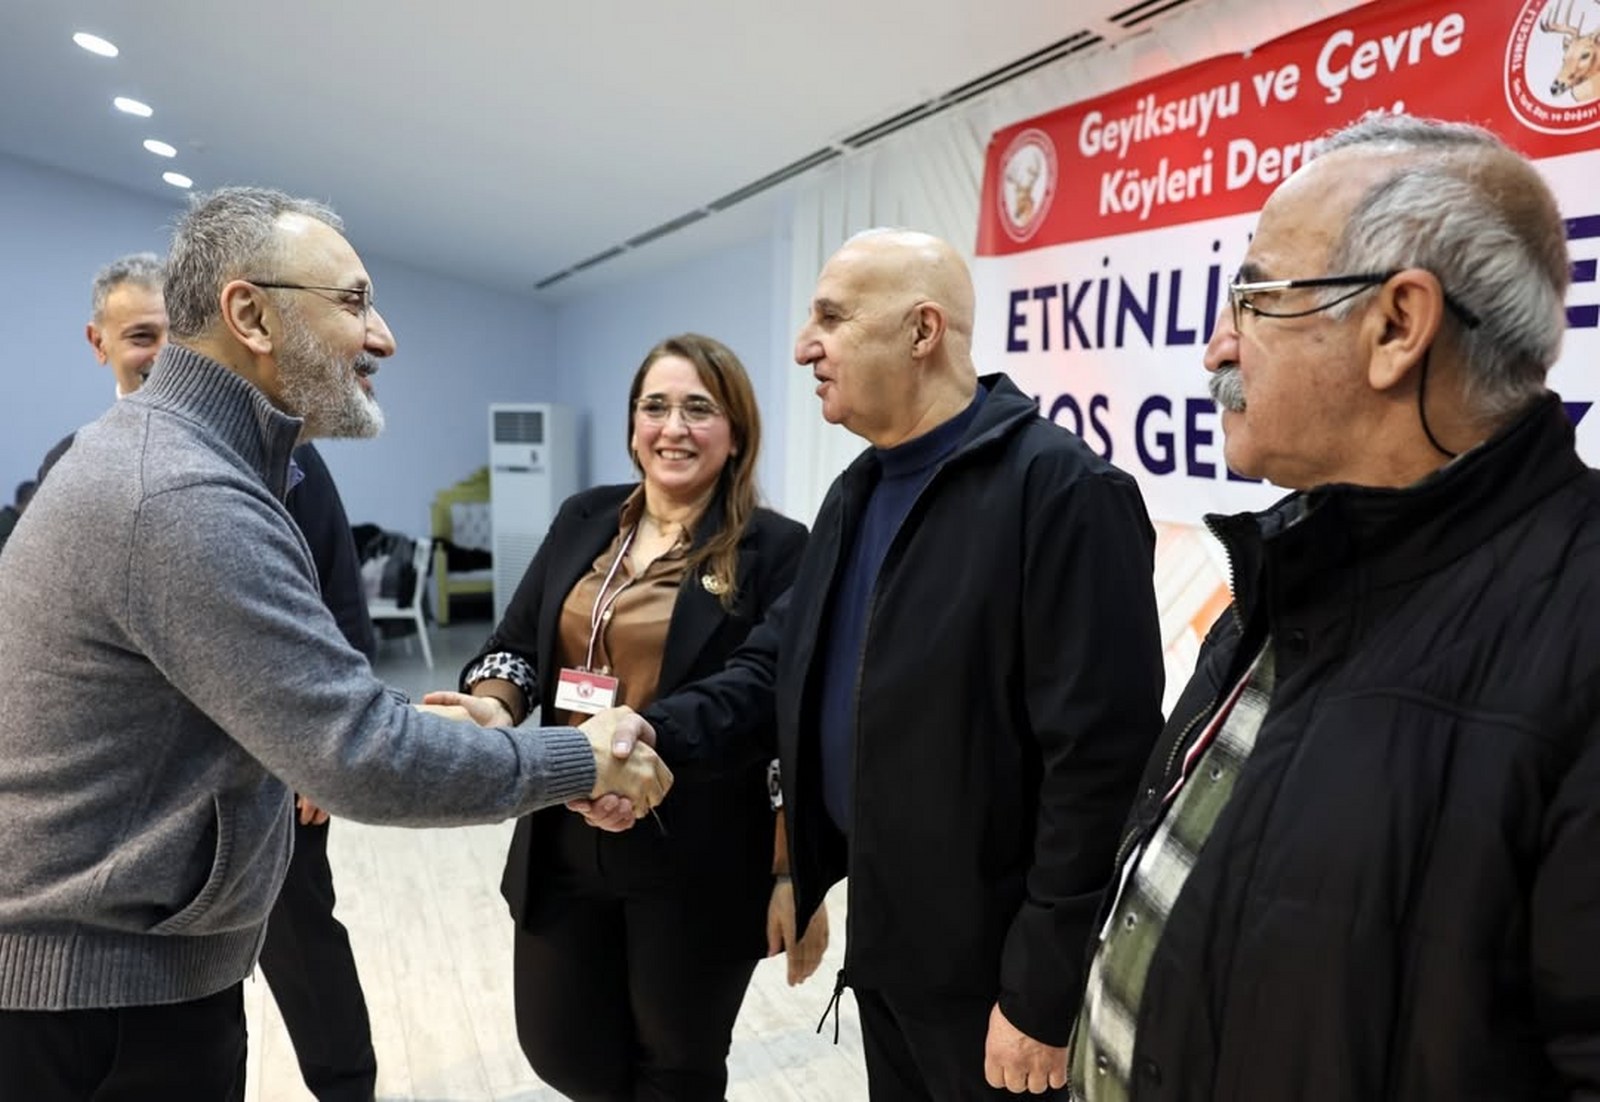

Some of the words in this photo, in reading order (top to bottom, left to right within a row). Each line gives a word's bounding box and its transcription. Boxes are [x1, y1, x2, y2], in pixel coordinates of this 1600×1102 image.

[1078, 81, 1240, 160] Geyiksuyu
[1252, 64, 1300, 107] ve
[1316, 13, 1465, 104] Çevre
[1100, 148, 1214, 221] Köyleri
[1006, 240, 1241, 354] ETKİNLİ
